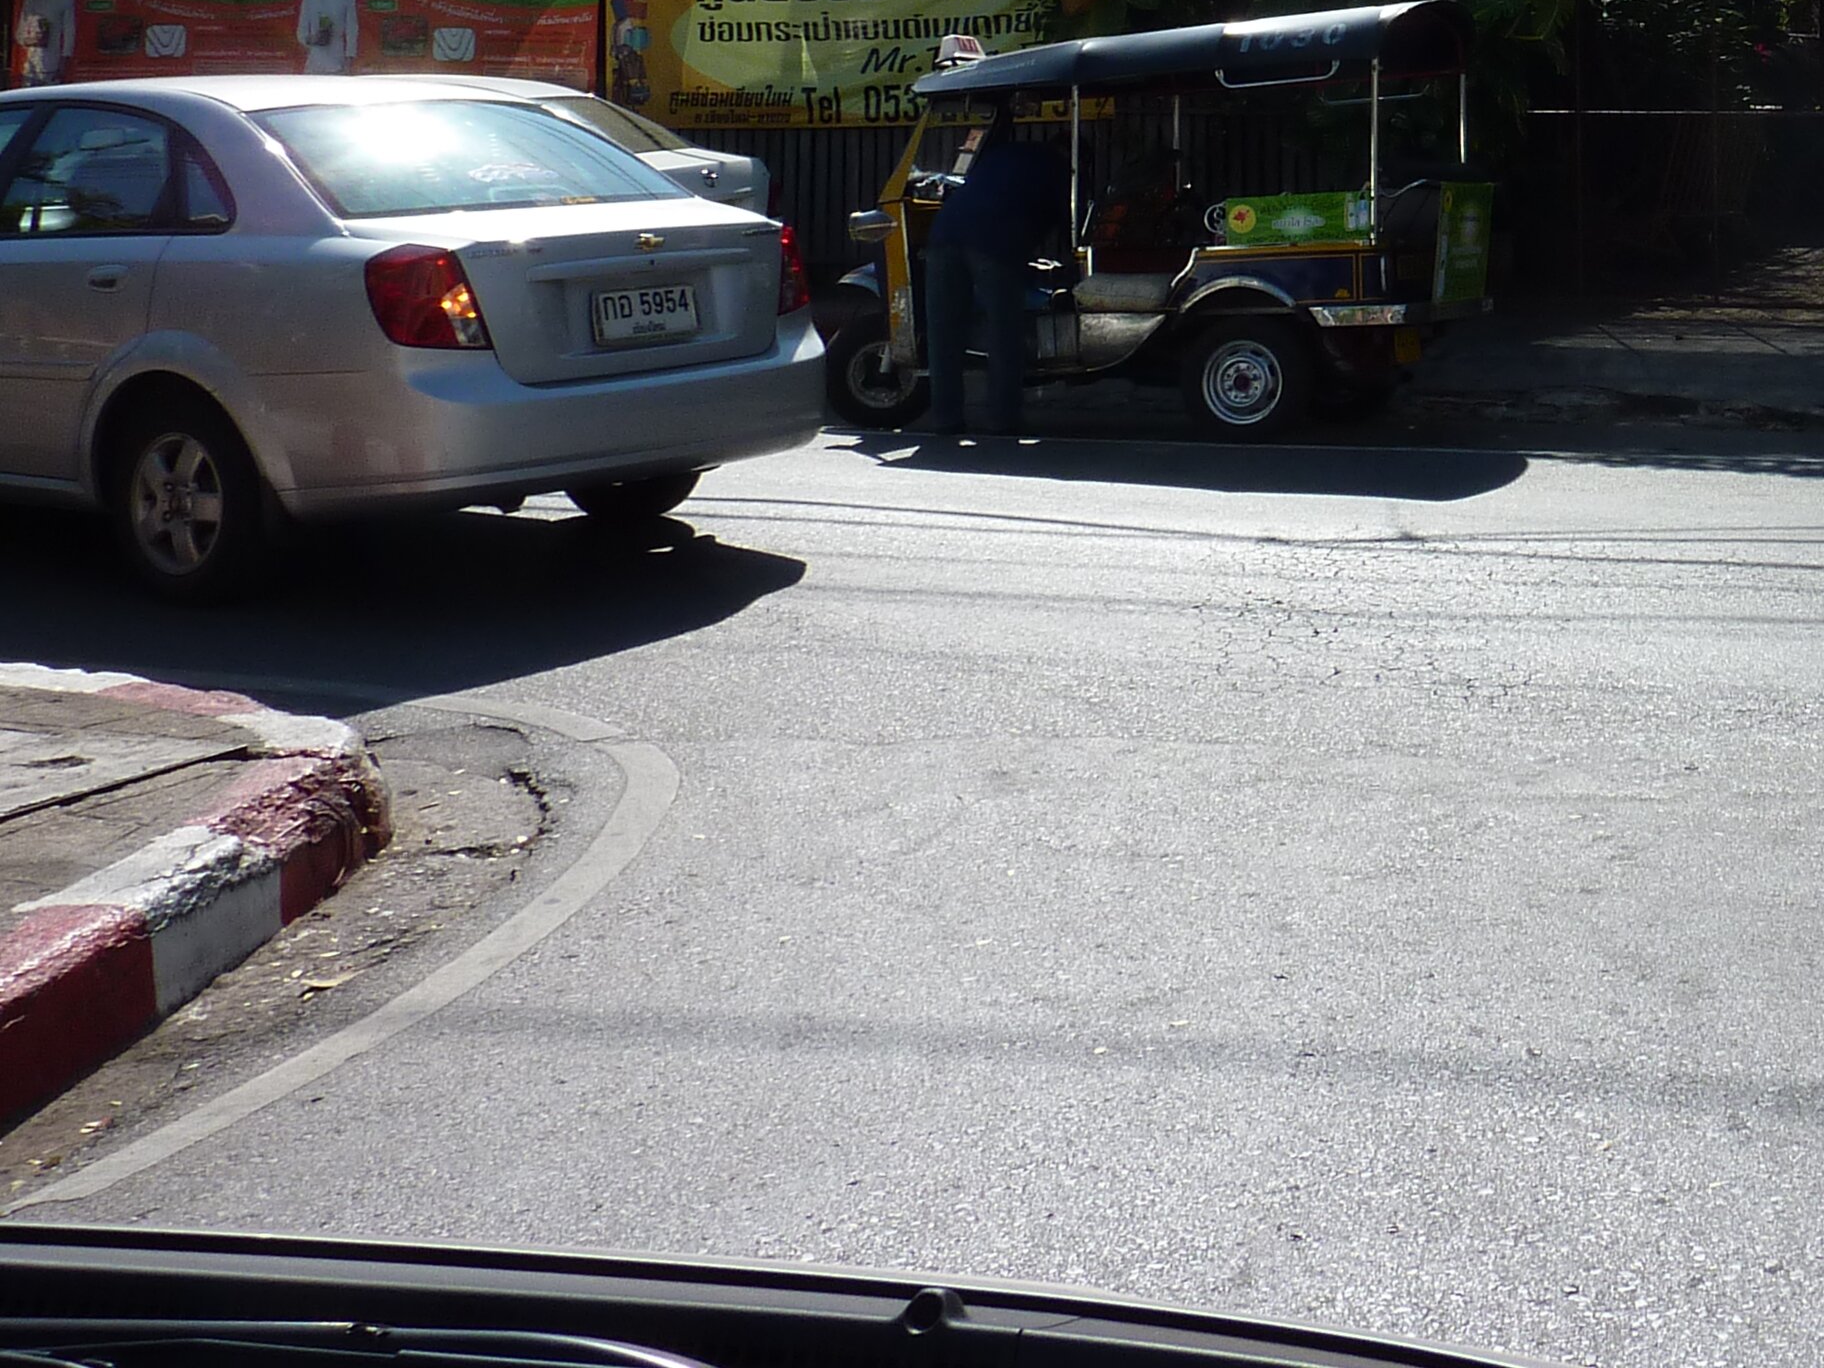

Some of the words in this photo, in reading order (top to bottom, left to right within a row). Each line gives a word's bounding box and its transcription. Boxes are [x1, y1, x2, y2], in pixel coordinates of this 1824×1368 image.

[861, 45, 922, 74] Mr.
[800, 84, 842, 125] Tel
[638, 288, 689, 316] 5954
